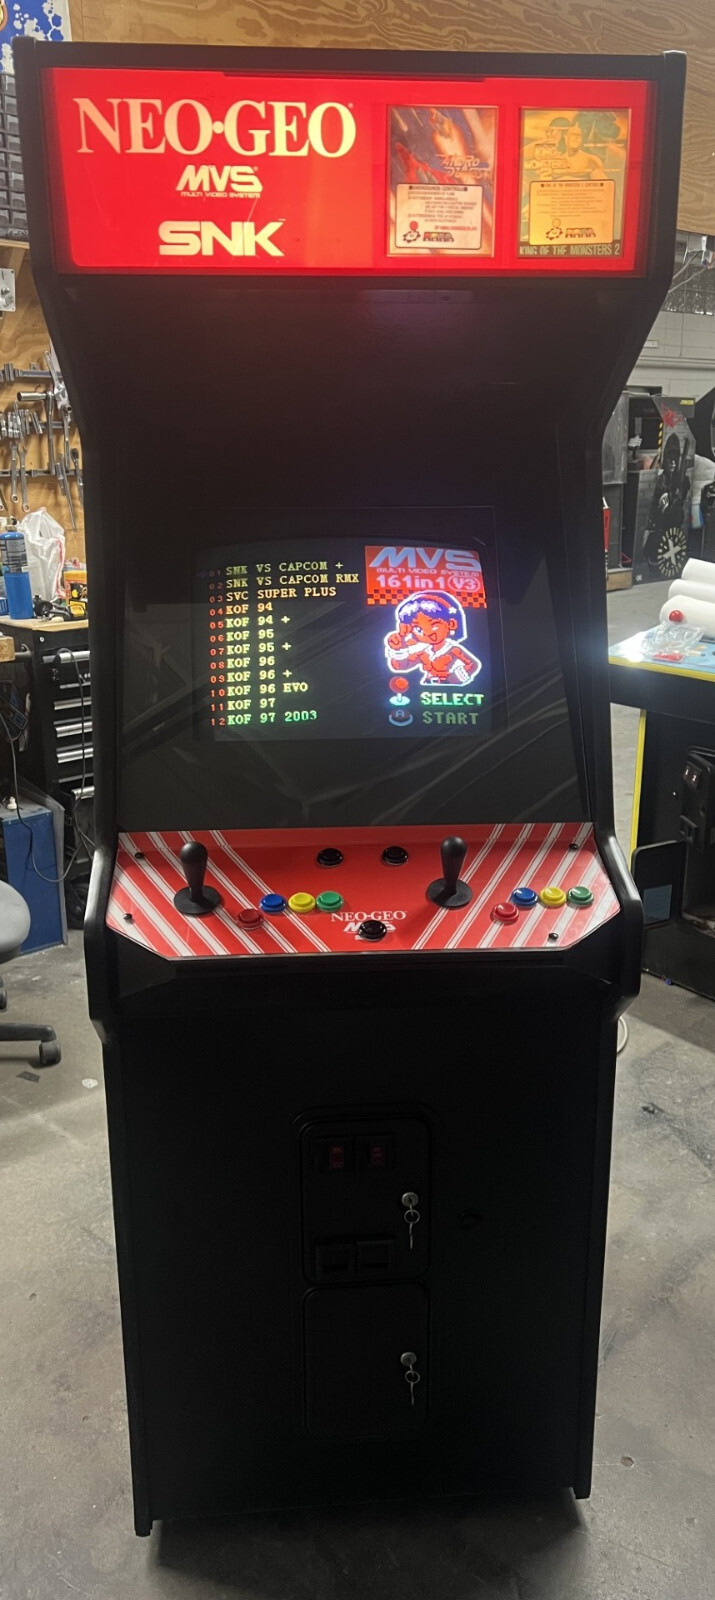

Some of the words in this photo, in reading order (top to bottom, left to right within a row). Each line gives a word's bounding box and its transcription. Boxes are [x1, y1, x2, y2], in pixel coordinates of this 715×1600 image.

[176, 165, 263, 192] MVS
[159, 221, 285, 257] SNK
[570, 244, 612, 255] MONSTERS
[614, 244, 620, 255] 2
[369, 547, 482, 572] MVS
[226, 566, 248, 575] SNK
[256, 564, 271, 573] VS
[279, 562, 327, 571] CAPCOM
[226, 579, 248, 588] SNK
[257, 577, 272, 585] VS
[280, 575, 328, 584] CAPCOM
[336, 574, 359, 583] RMX
[209, 595, 223, 603] 03
[226, 592, 248, 601] SVC
[257, 589, 297, 599] SUPER
[305, 587, 336, 596] PLUS
[210, 608, 223, 616] 04
[226, 605, 248, 615] KOF
[257, 602, 273, 611] 94
[210, 621, 224, 629] 05
[226, 618, 249, 628] KOF
[258, 615, 273, 625] 94
[210, 634, 224, 642] 06
[226, 631, 249, 641] KOF
[258, 629, 274, 638] 95
[210, 648, 224, 656] 07
[227, 644, 250, 655] KOF
[259, 643, 274, 652] 95
[211, 661, 225, 669] 08
[227, 658, 250, 668] KOF
[259, 656, 275, 666] 96
[227, 671, 251, 682] KOF
[259, 670, 275, 680] 96
[211, 689, 225, 697] 10
[227, 685, 251, 696] KOF
[260, 684, 275, 693] 96
[283, 682, 308, 692] EVO
[211, 703, 224, 711] 11
[228, 700, 251, 710] KOF
[260, 698, 275, 708] 97
[421, 692, 484, 706] SELECT
[211, 718, 225, 726] 12
[228, 714, 251, 725] KOF
[260, 713, 276, 723] 97
[285, 710, 317, 722] 2003
[423, 712, 478, 725] START
